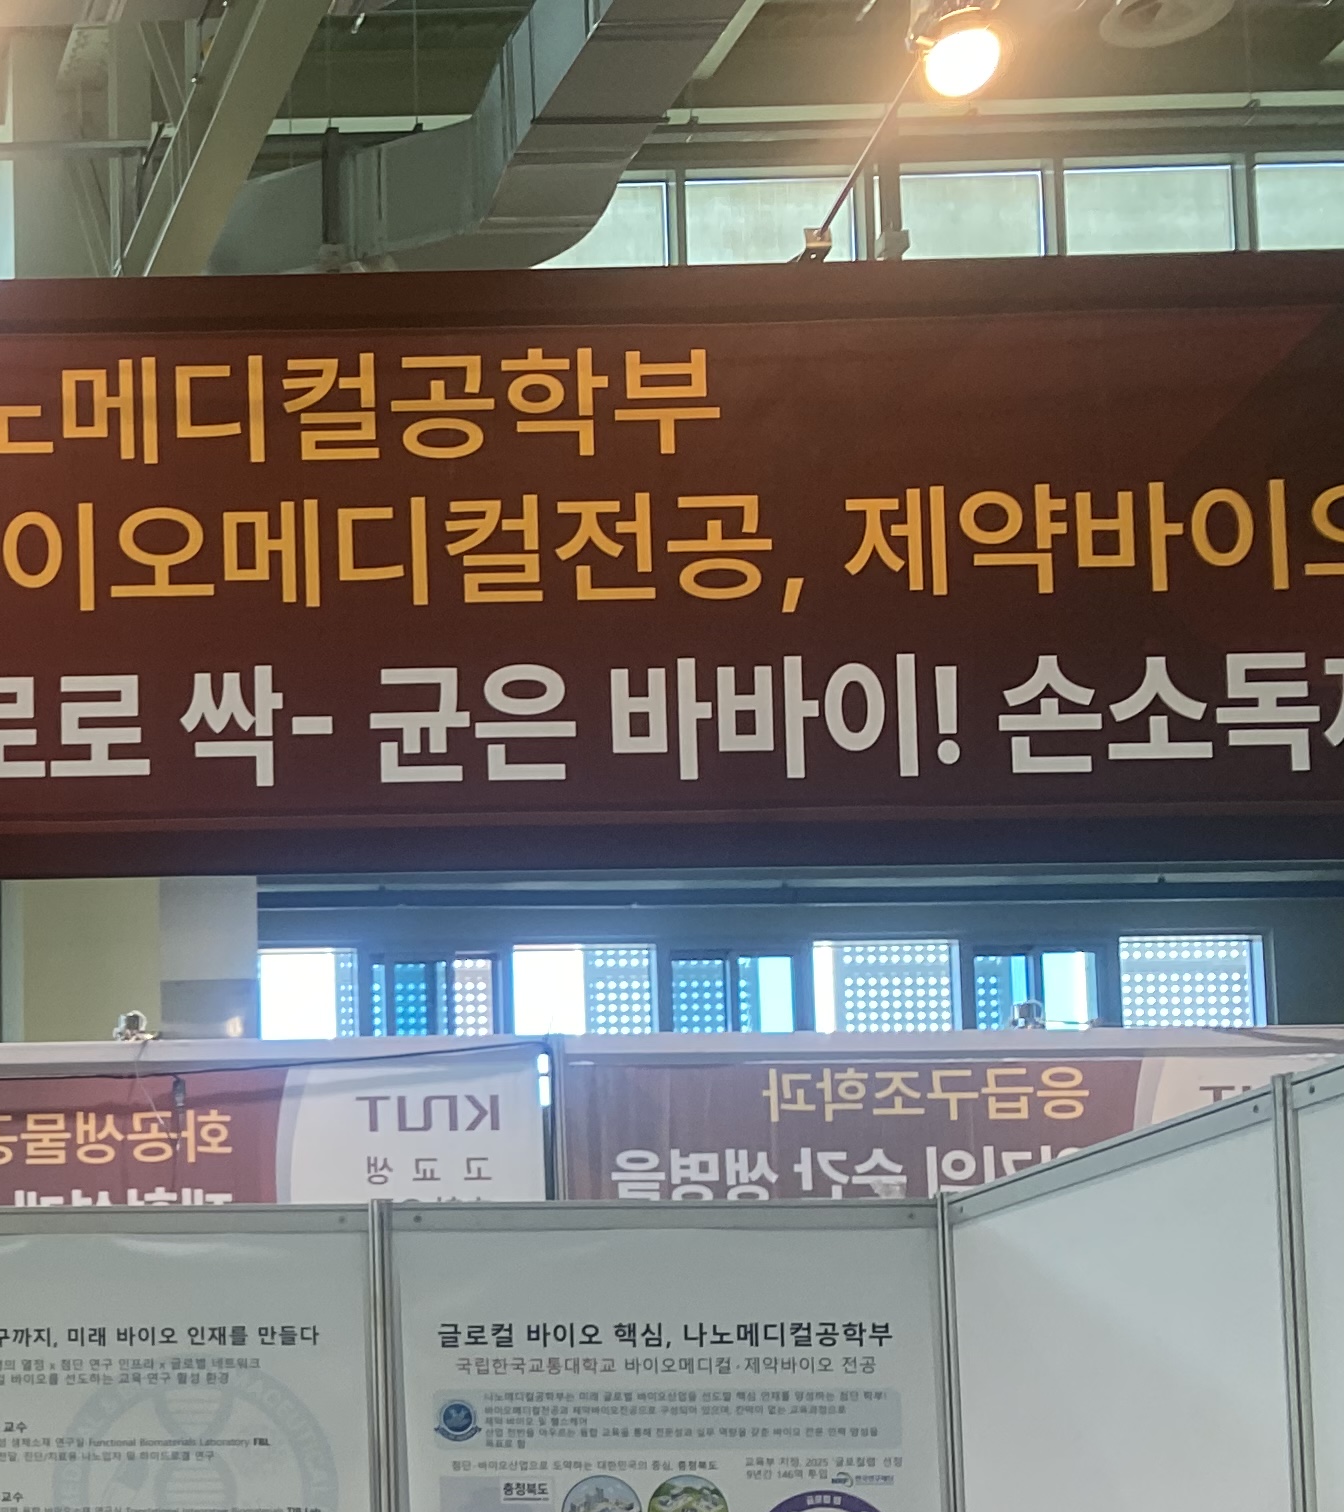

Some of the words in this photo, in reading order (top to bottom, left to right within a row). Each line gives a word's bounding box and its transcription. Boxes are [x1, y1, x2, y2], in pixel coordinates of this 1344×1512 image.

[180, 667, 334, 786] 싹-
[369, 662, 579, 783] 균은
[611, 653, 961, 780] 바바이!
[998, 649, 1344, 774] 손소독
[67, 1326, 107, 1348] 미래
[116, 1326, 178, 1347] 바이오
[187, 1325, 248, 1347] 인재를
[257, 1325, 320, 1346] 만들다
[437, 1322, 514, 1349] 글로컬
[526, 1322, 603, 1349] 바이오
[613, 1322, 671, 1349] 핵심,
[683, 1321, 893, 1348] 나노메디컬공학부
[88, 1358, 113, 1372] 연구
[456, 1356, 616, 1376] 국립한국교통대학교
[842, 1355, 876, 1375] 전공
[146, 1371, 171, 1385] 연구
[3, 1421, 28, 1434] 교수
[1, 1491, 24, 1503] 교수
